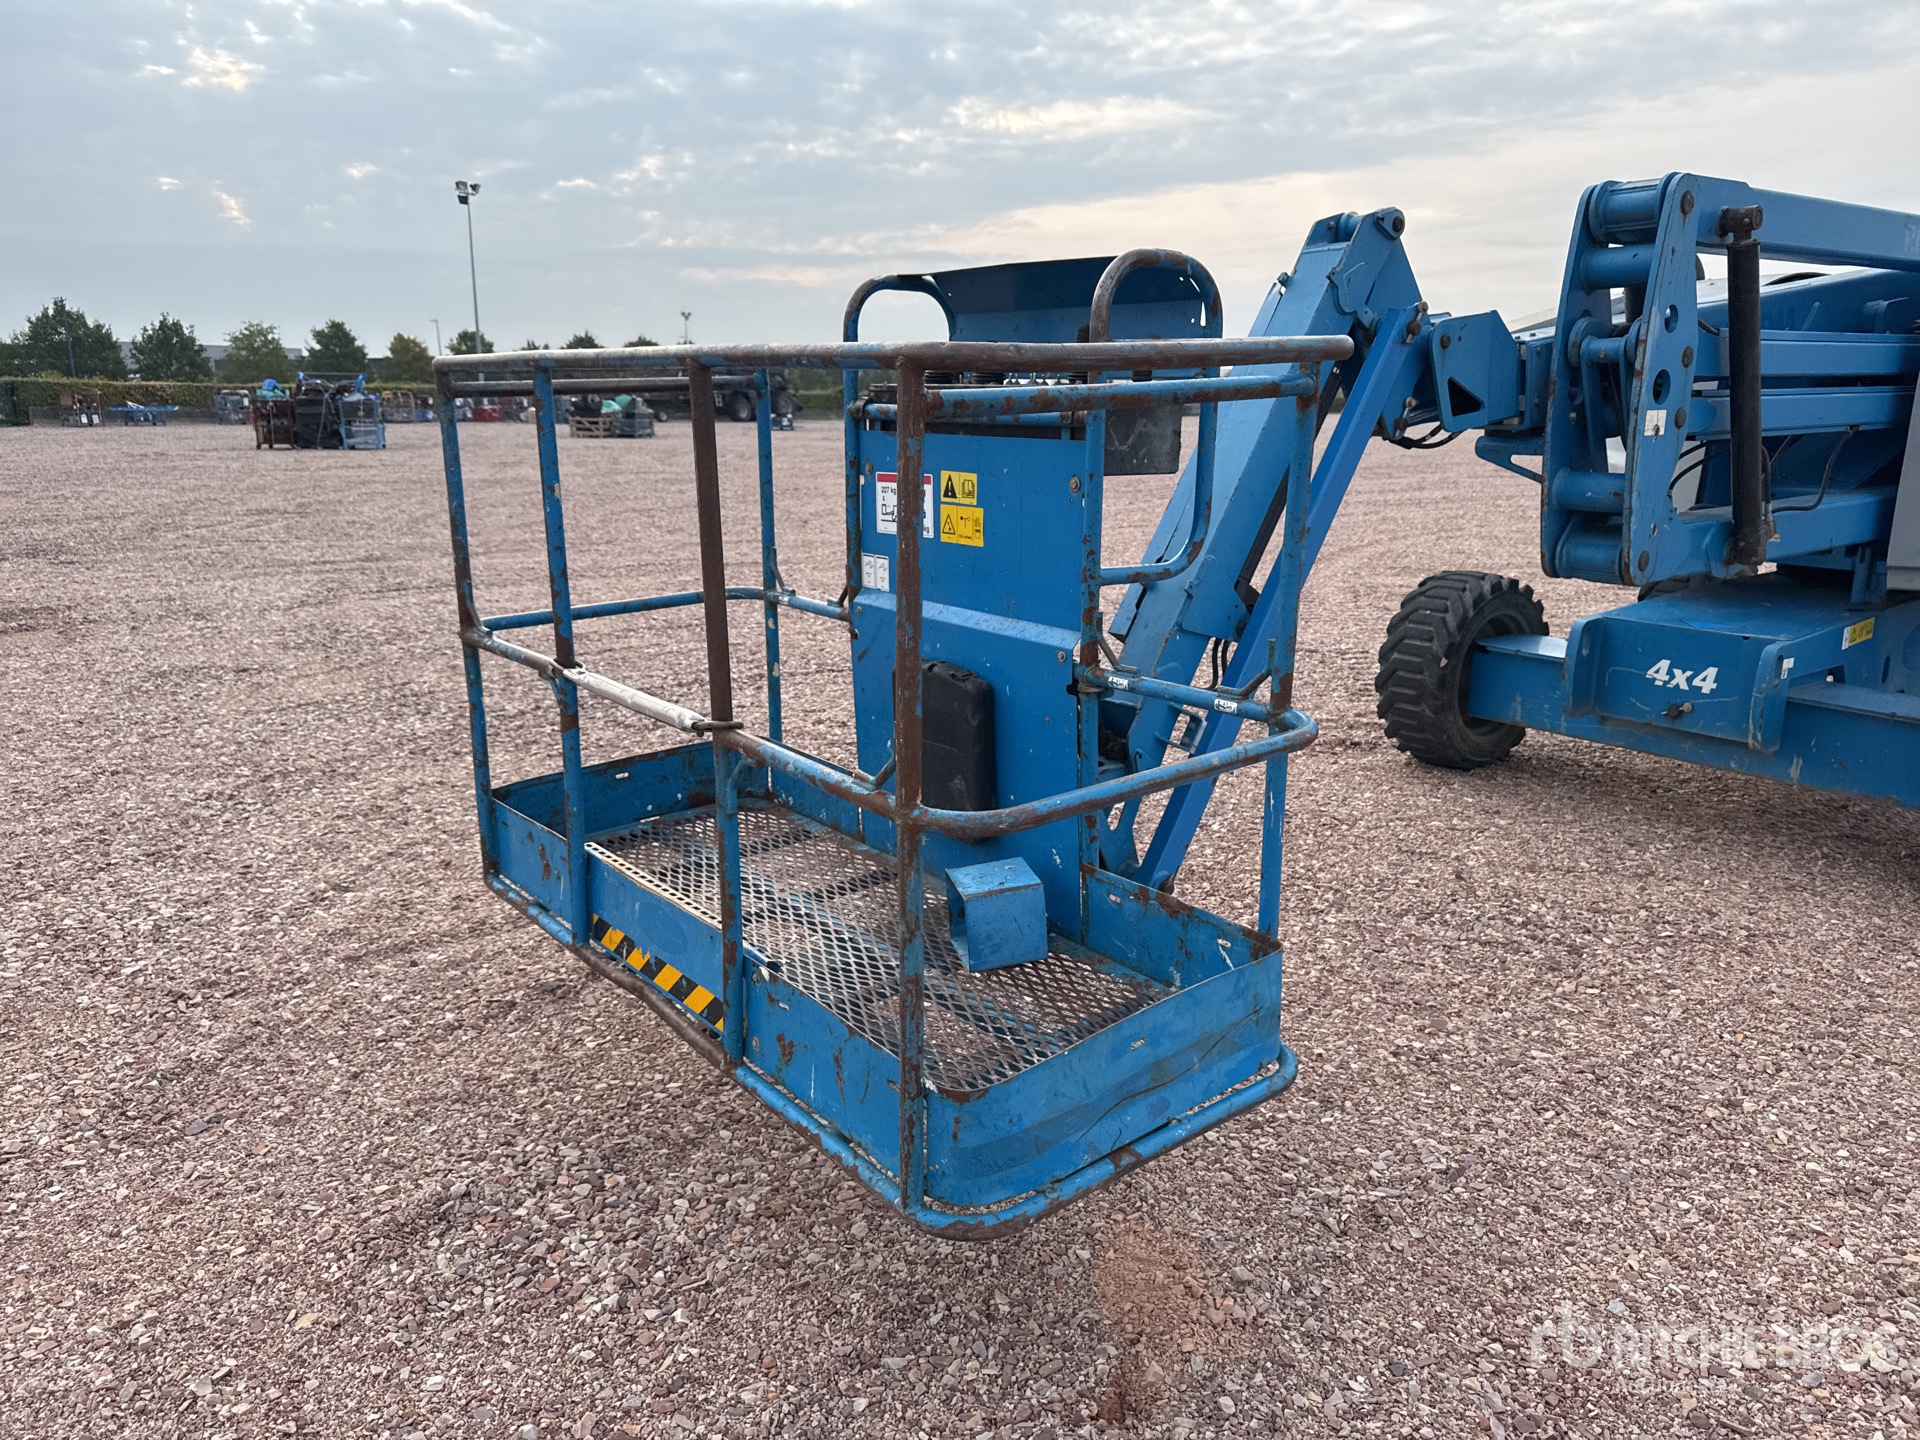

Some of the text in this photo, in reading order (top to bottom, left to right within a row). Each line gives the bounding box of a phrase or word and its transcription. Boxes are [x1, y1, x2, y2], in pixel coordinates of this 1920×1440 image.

[881, 486, 897, 496] 227 kg
[1645, 658, 1719, 695] 4x4
